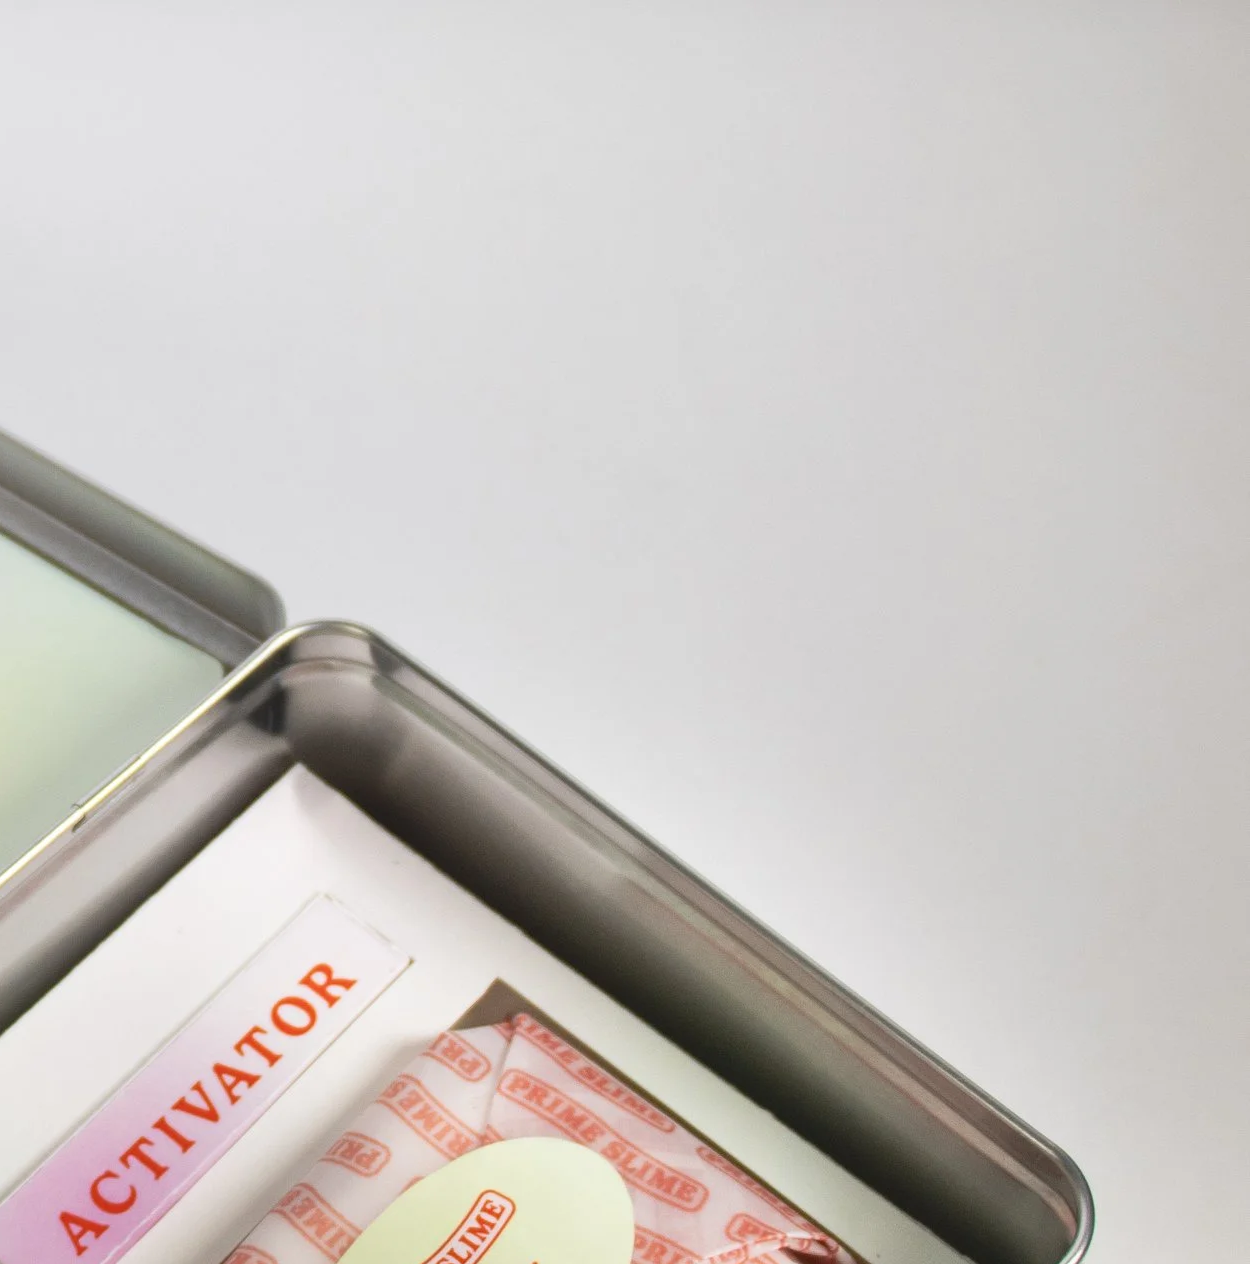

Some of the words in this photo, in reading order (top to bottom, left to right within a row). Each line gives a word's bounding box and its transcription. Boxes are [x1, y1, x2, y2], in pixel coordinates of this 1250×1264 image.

[59, 963, 358, 1257] ACTIVATOR
[396, 1088, 474, 1156] RIME
[506, 1074, 605, 1143] PRIME
[602, 1140, 699, 1202] SLIME
